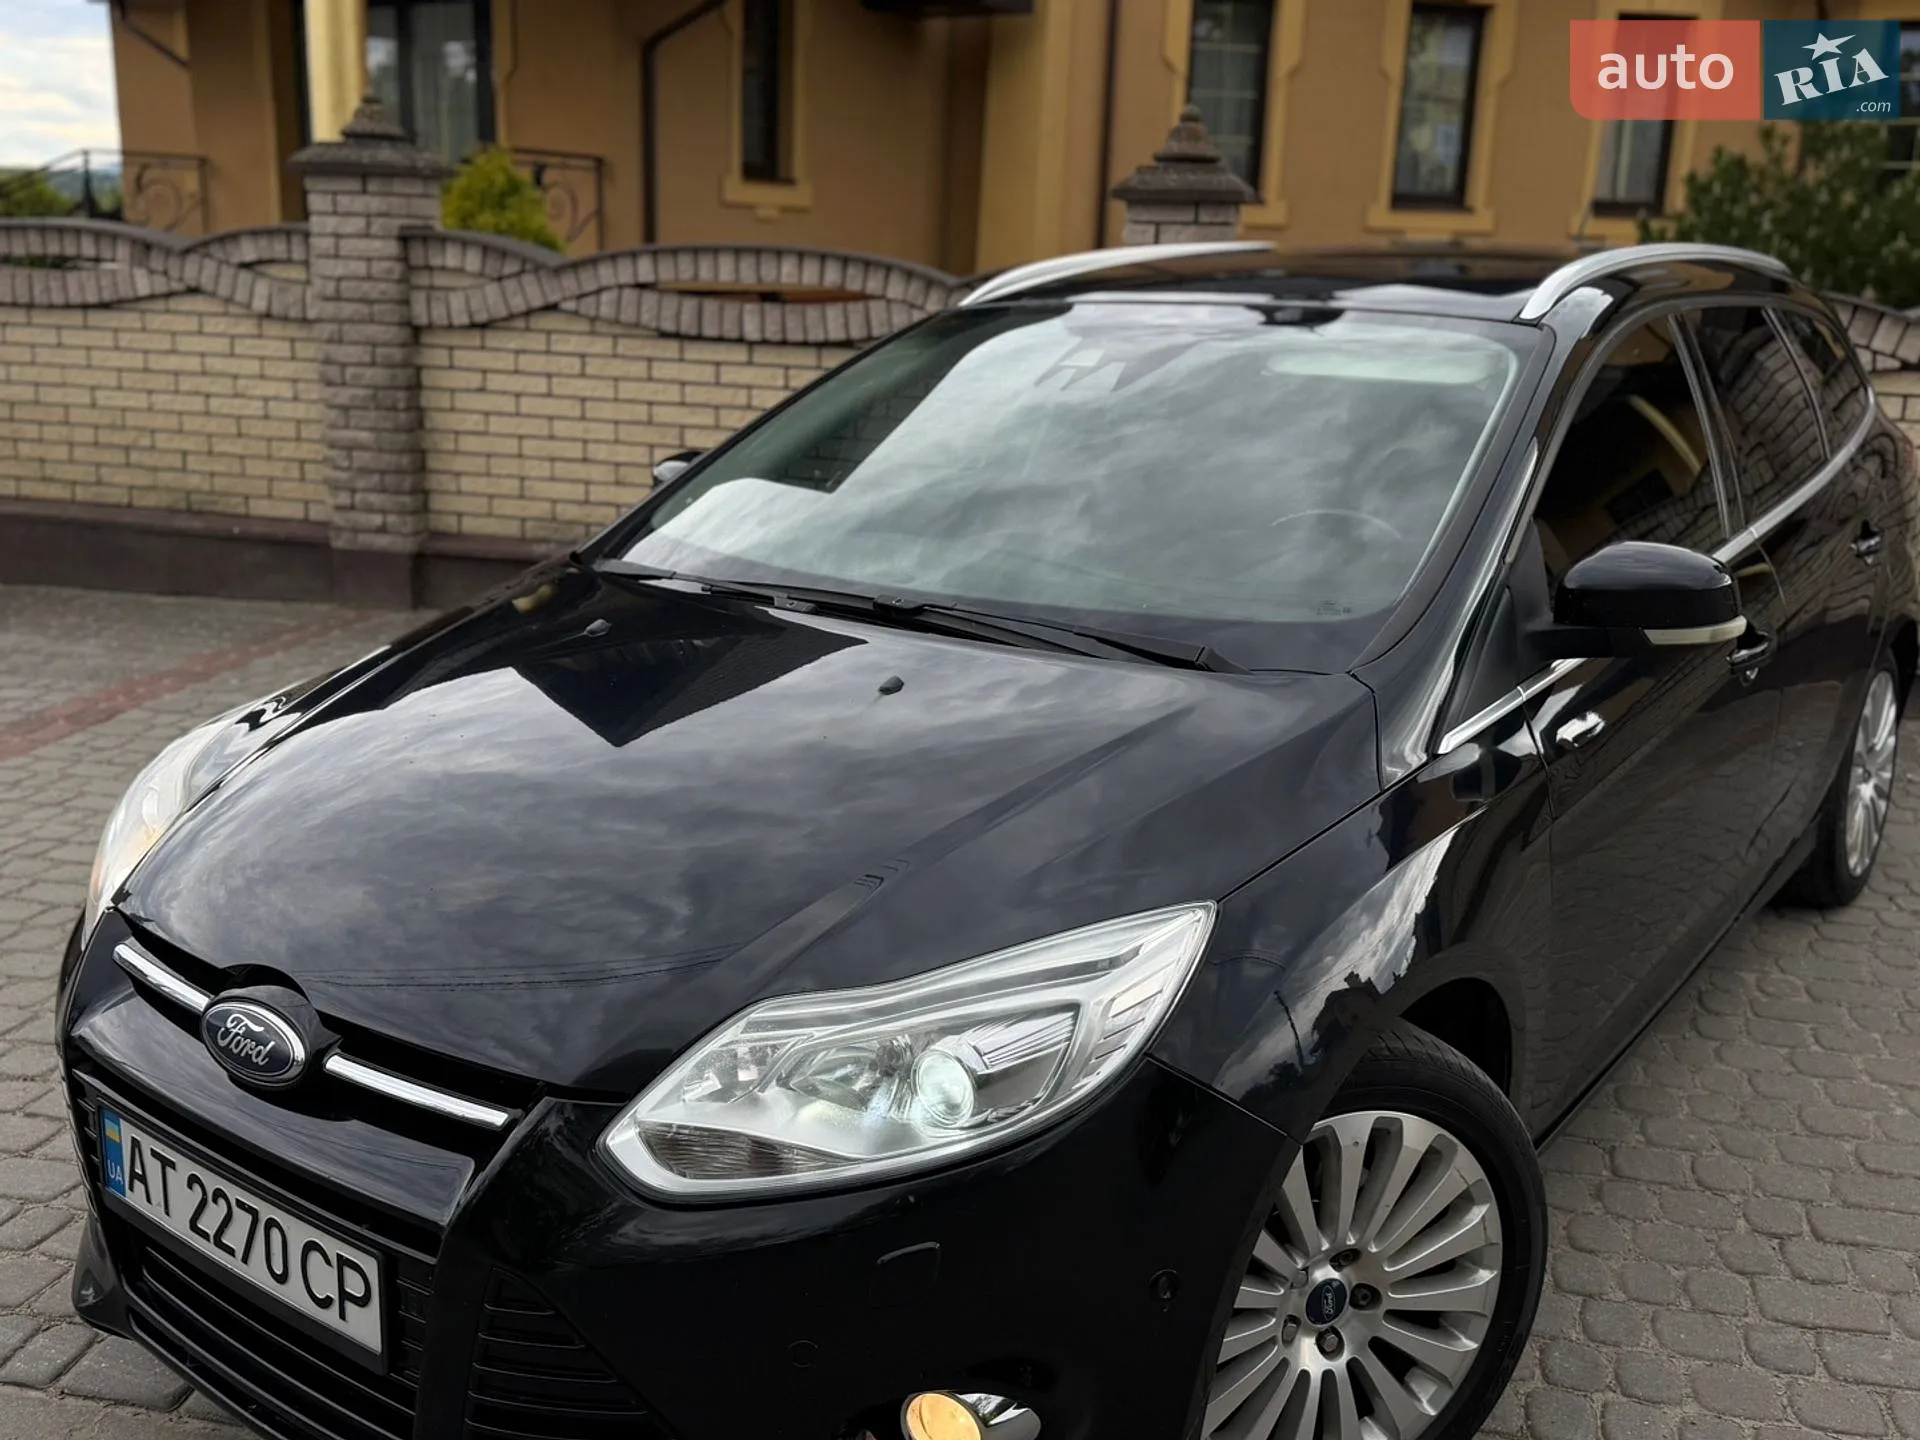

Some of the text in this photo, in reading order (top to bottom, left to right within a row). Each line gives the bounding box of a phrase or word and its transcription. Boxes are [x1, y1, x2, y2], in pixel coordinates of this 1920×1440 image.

[217, 1013, 275, 1066] Ford
[107, 1159, 123, 1184] UA
[128, 1135, 372, 1321] AT 2270 CP
